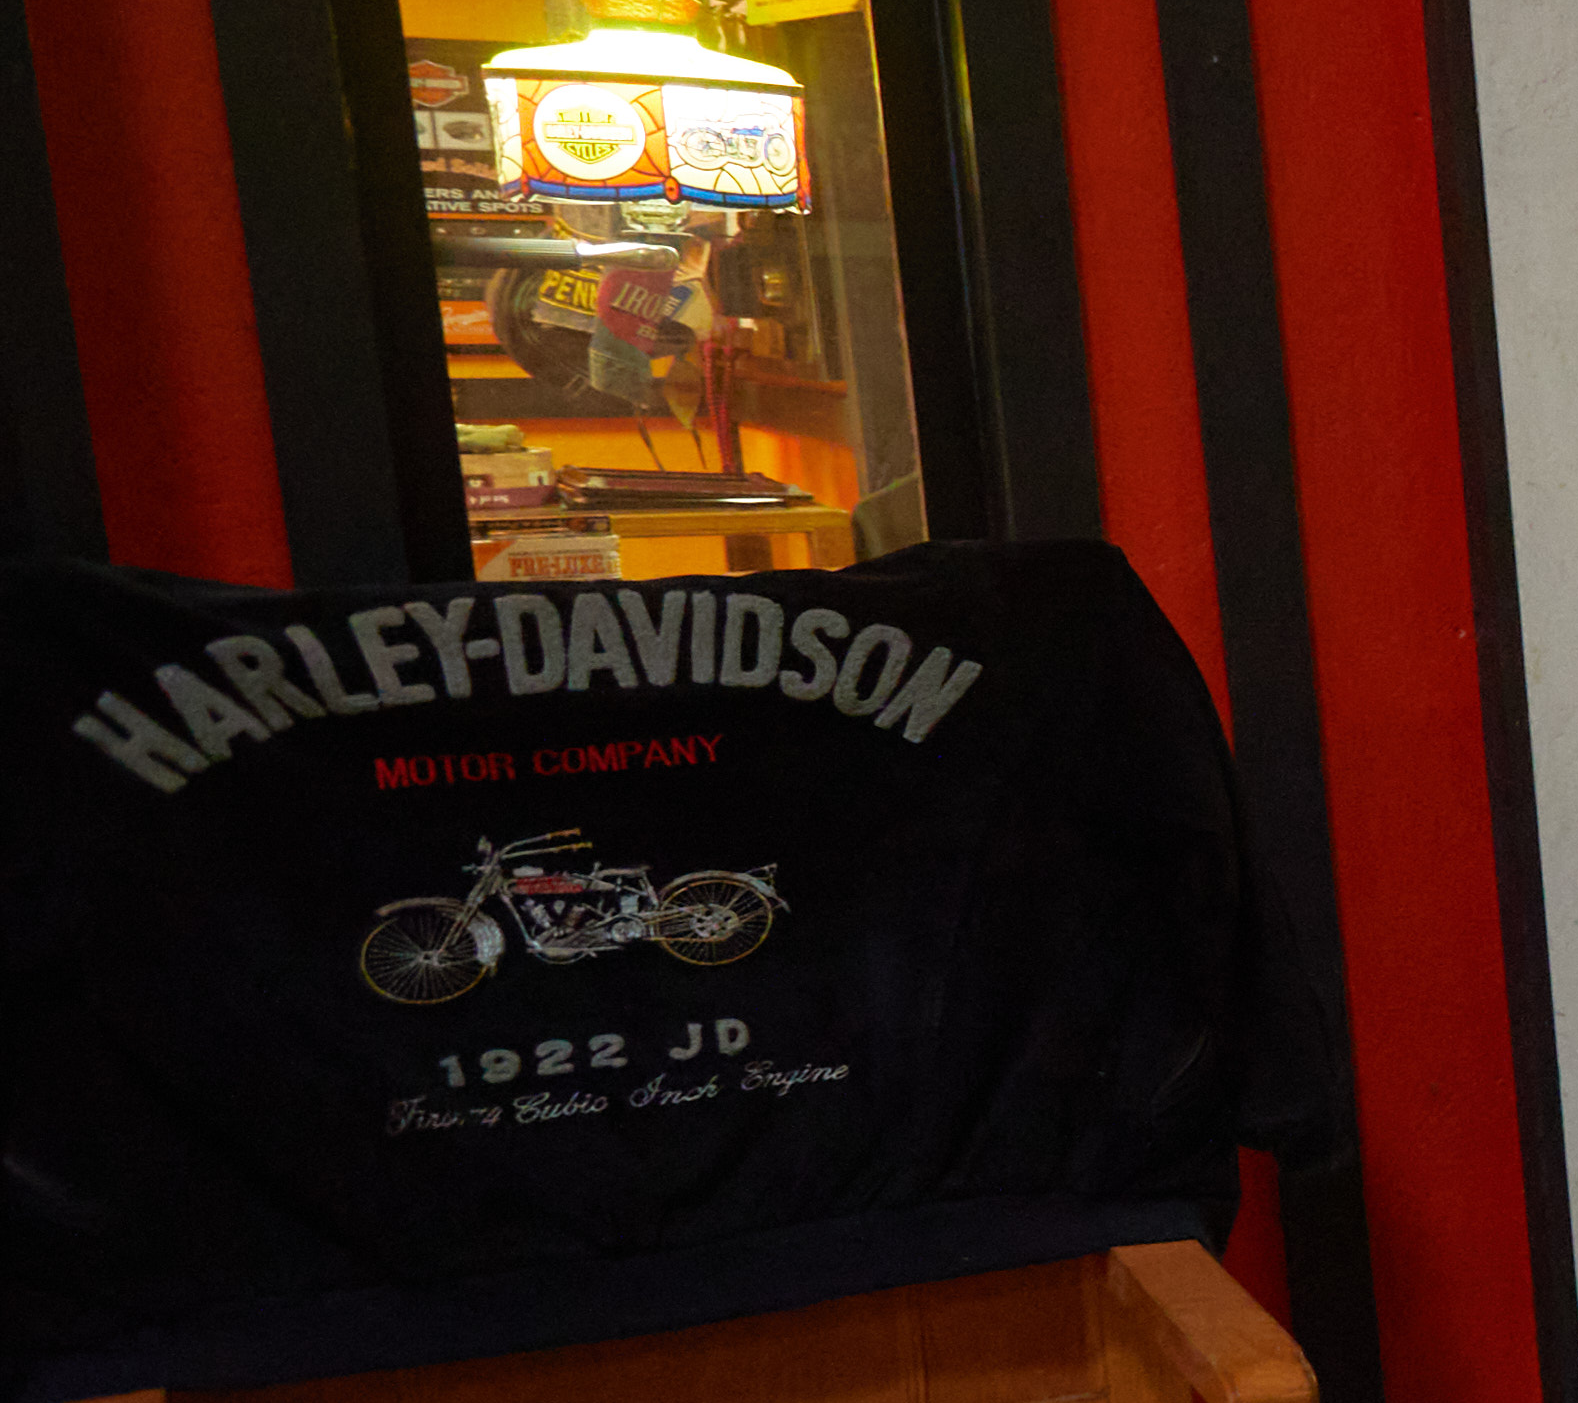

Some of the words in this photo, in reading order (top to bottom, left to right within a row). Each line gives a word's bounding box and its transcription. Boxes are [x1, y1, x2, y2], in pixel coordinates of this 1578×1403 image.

[480, 201, 544, 214] SPOTS
[72, 589, 984, 795] HARLEY-DAVIDSON
[374, 749, 518, 792] MOTOR
[532, 731, 725, 777] COMPANY
[438, 1032, 632, 1088] 1922
[668, 1015, 753, 1061] JD
[629, 1071, 723, 1114] Inch
[740, 1056, 852, 1097] Engine
